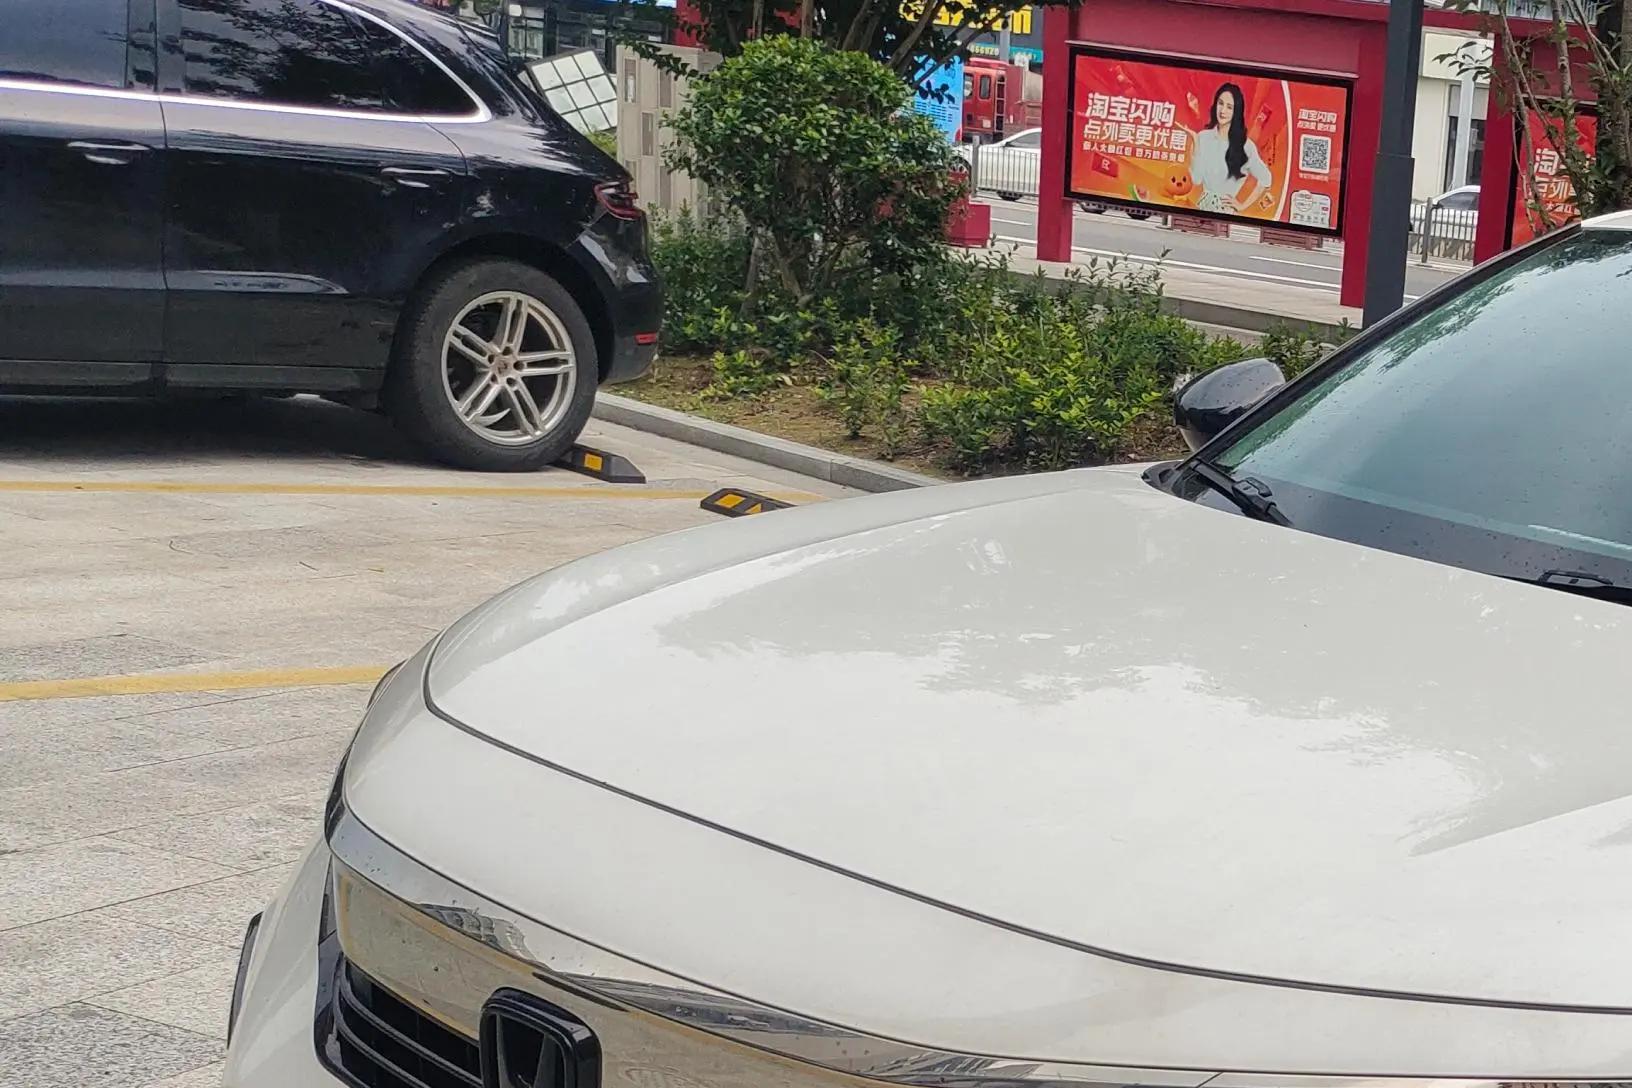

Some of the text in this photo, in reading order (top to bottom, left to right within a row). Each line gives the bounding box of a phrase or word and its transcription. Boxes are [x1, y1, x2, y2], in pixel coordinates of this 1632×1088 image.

[1085, 92, 1176, 127] 淘宝闪购
[1083, 119, 1188, 151] 点外卖更优惠
